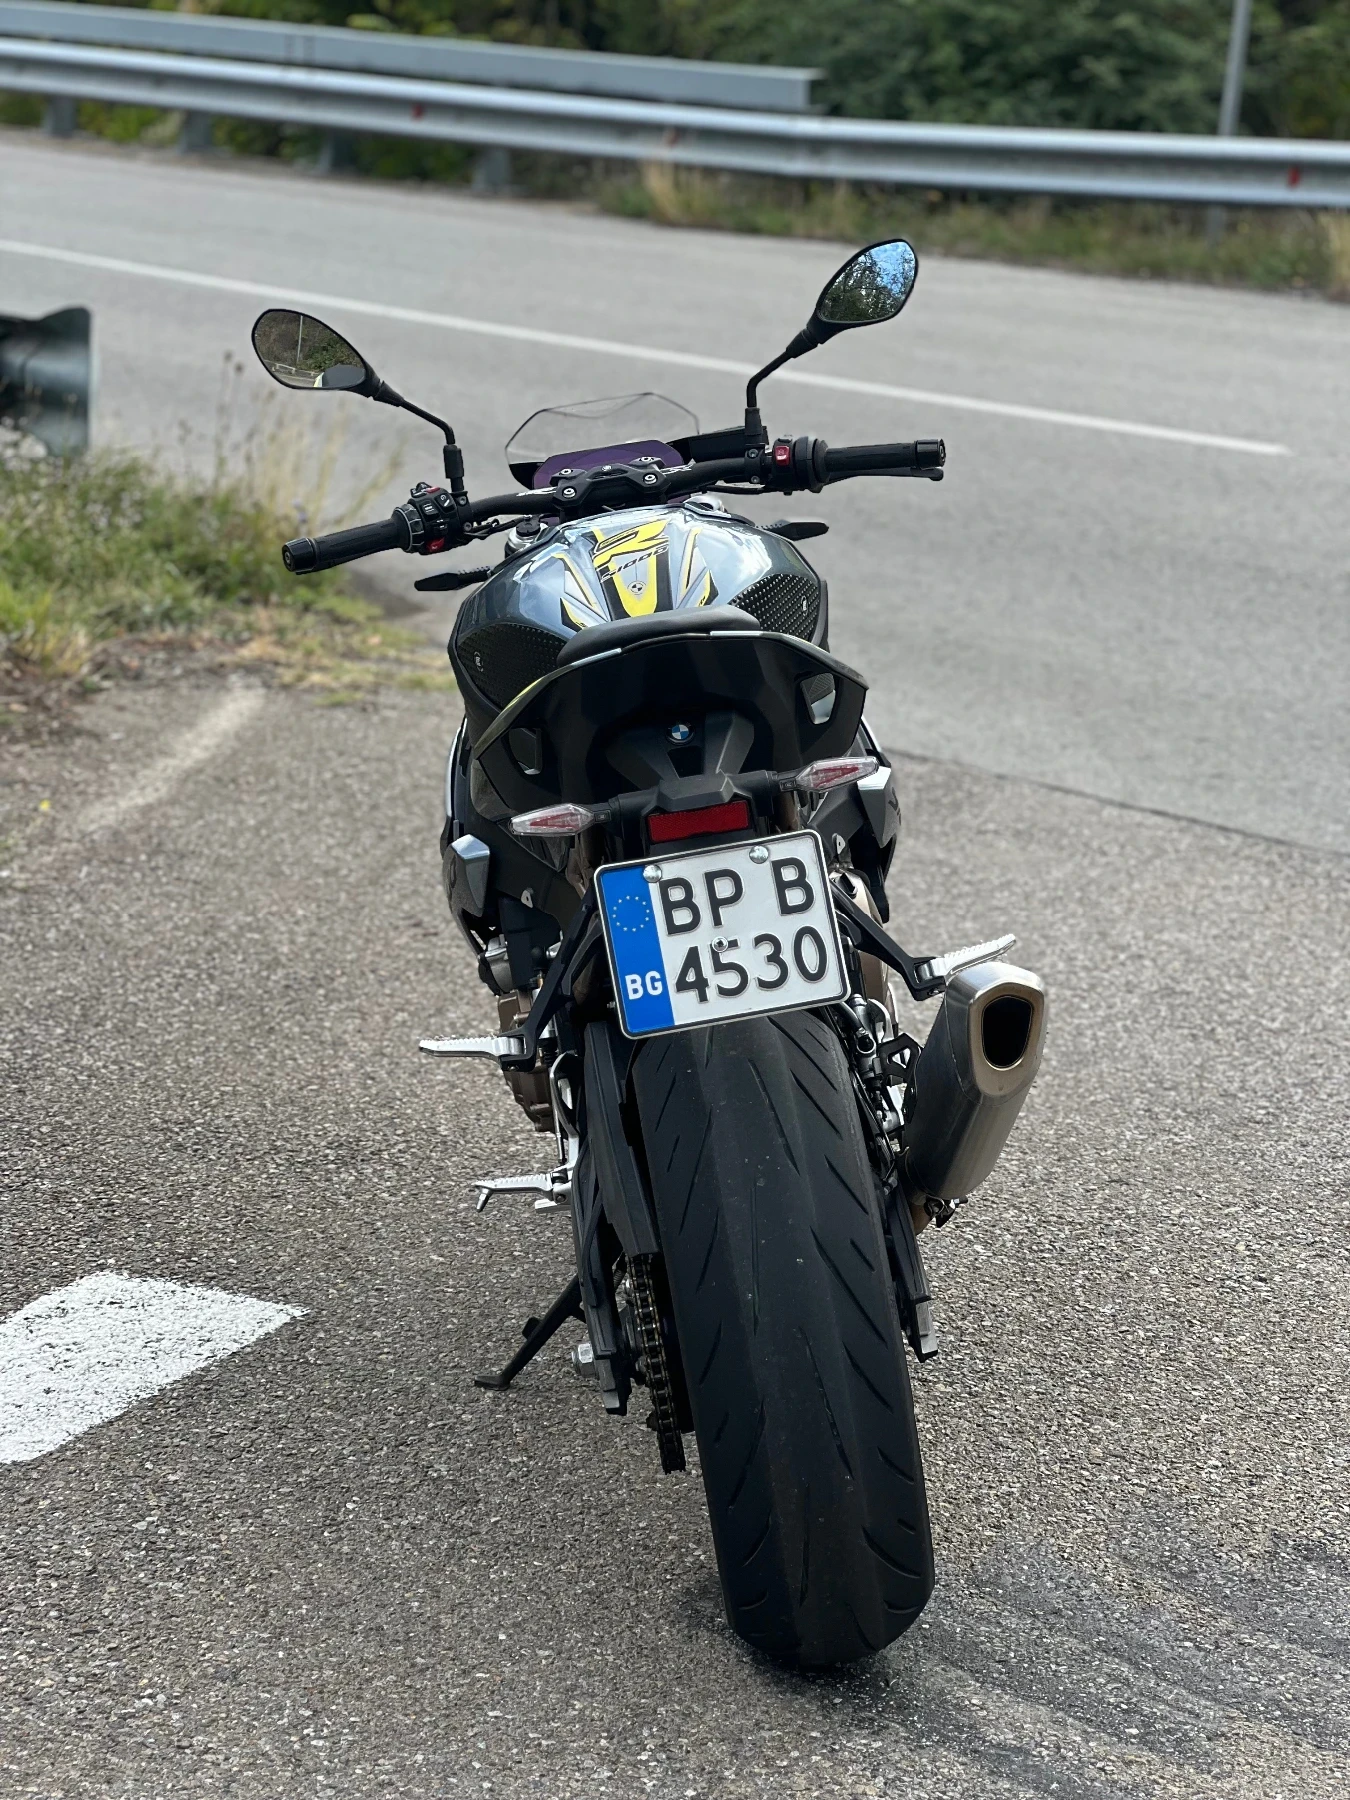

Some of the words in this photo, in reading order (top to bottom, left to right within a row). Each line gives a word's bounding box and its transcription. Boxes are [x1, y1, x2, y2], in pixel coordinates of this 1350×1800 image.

[658, 868, 744, 936] BP
[771, 857, 815, 916] B
[625, 971, 663, 1000] BG
[675, 925, 828, 1004] 4530
